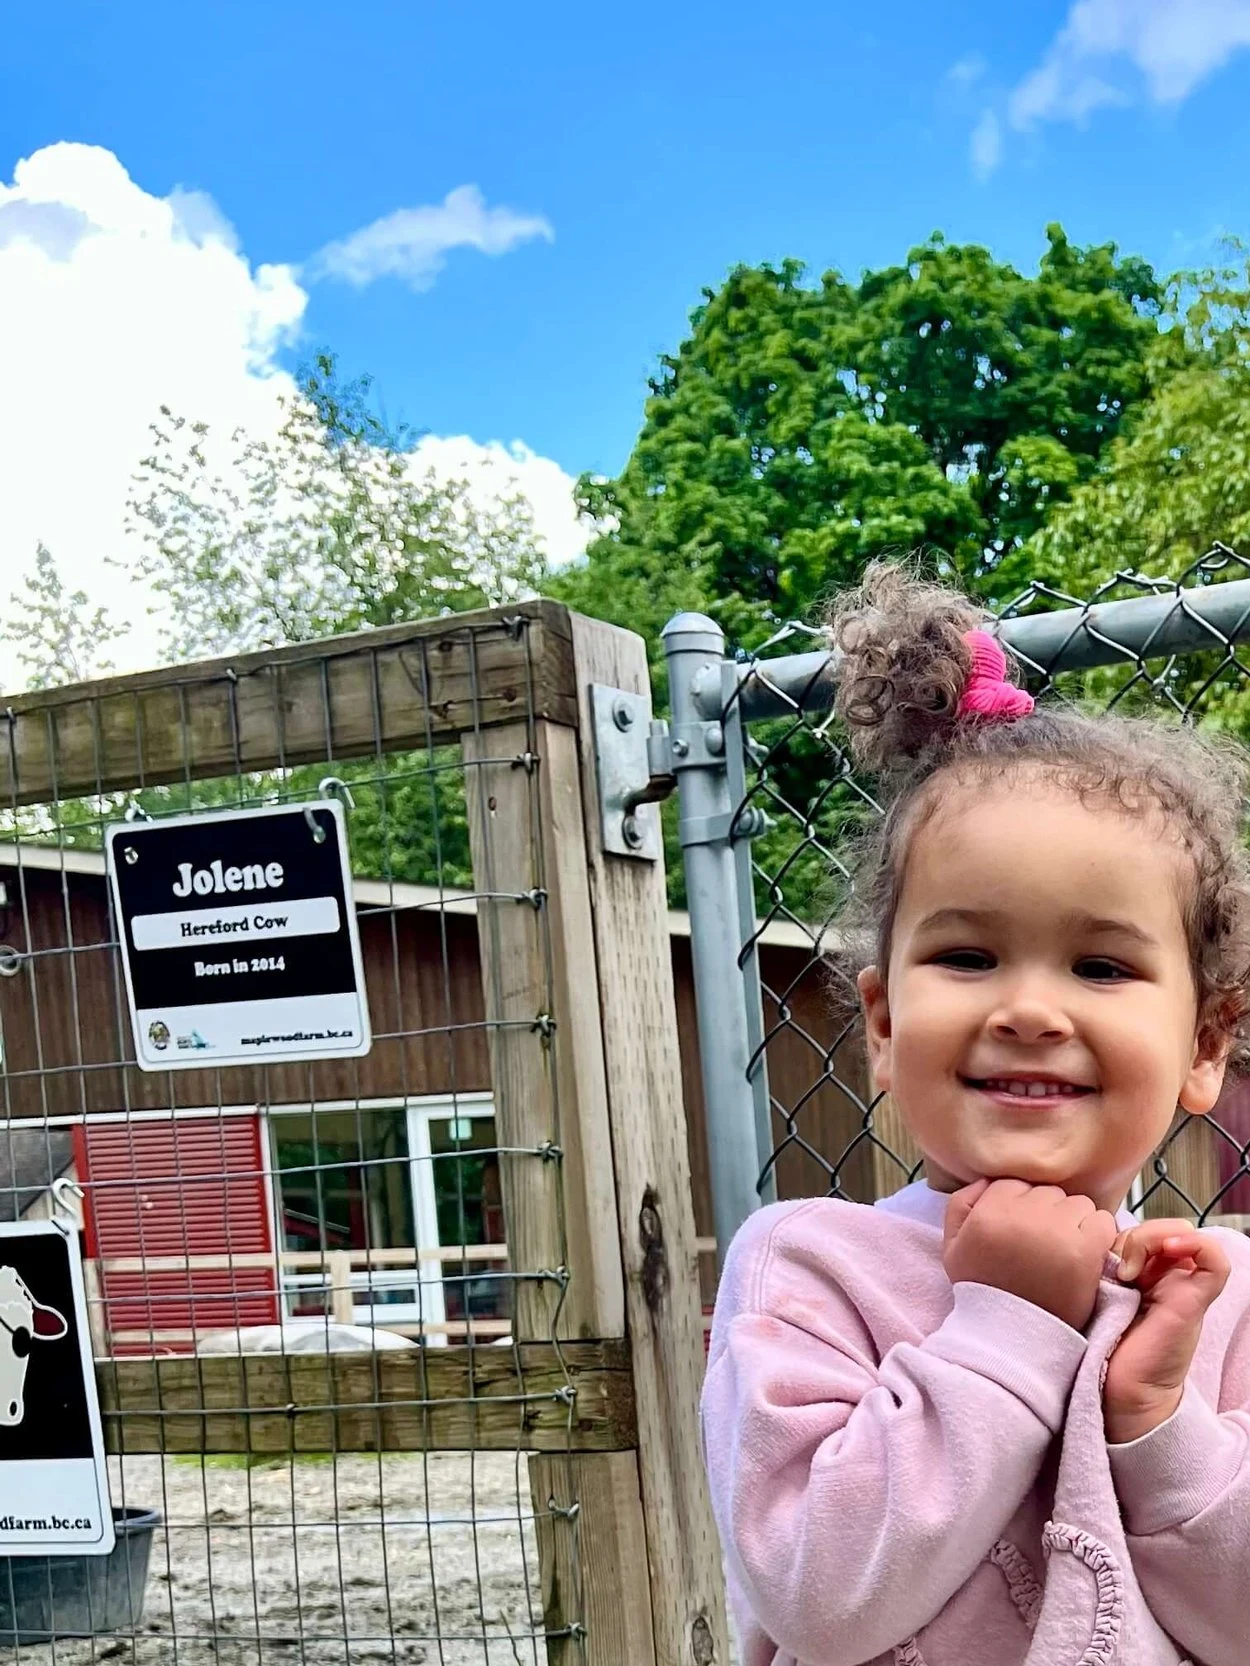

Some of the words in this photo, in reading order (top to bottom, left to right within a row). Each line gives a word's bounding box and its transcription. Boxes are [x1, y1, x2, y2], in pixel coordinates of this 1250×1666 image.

[172, 859, 284, 897] Jolene
[180, 917, 250, 937] Hereford
[253, 915, 289, 931] Cow
[194, 961, 231, 977] Born
[232, 958, 249, 974] in
[250, 955, 286, 972] 2014
